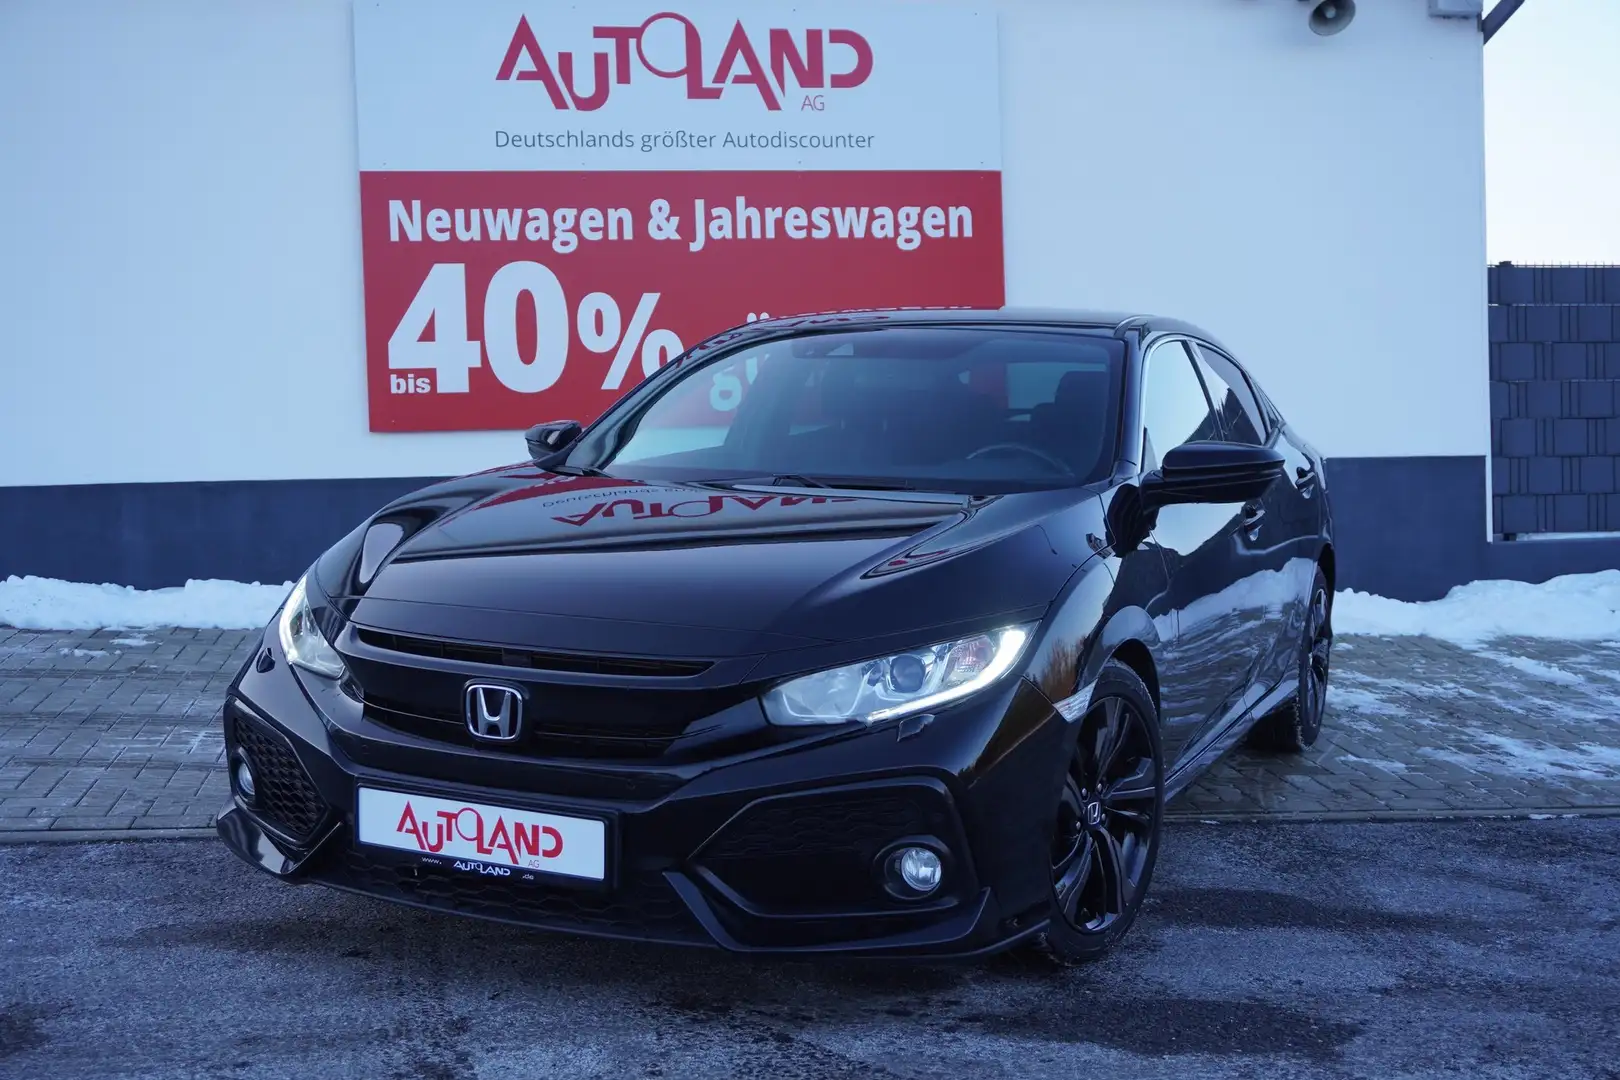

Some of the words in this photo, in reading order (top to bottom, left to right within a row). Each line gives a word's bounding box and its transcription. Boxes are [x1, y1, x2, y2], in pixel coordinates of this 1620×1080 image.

[496, 11, 873, 111] AUTOLAND
[801, 94, 825, 112] AG
[496, 130, 634, 148] Deutschlands
[641, 130, 716, 153] größter
[722, 131, 874, 149] Autodiscounter
[389, 199, 633, 254] Neuwagen
[647, 199, 681, 241] &
[690, 196, 973, 252] Jahreswagen
[387, 260, 684, 394] 40%
[390, 374, 431, 394] bis
[396, 800, 563, 865] AUTOLAND
[453, 860, 511, 876] AUTOLAND
[527, 859, 540, 869] AG
